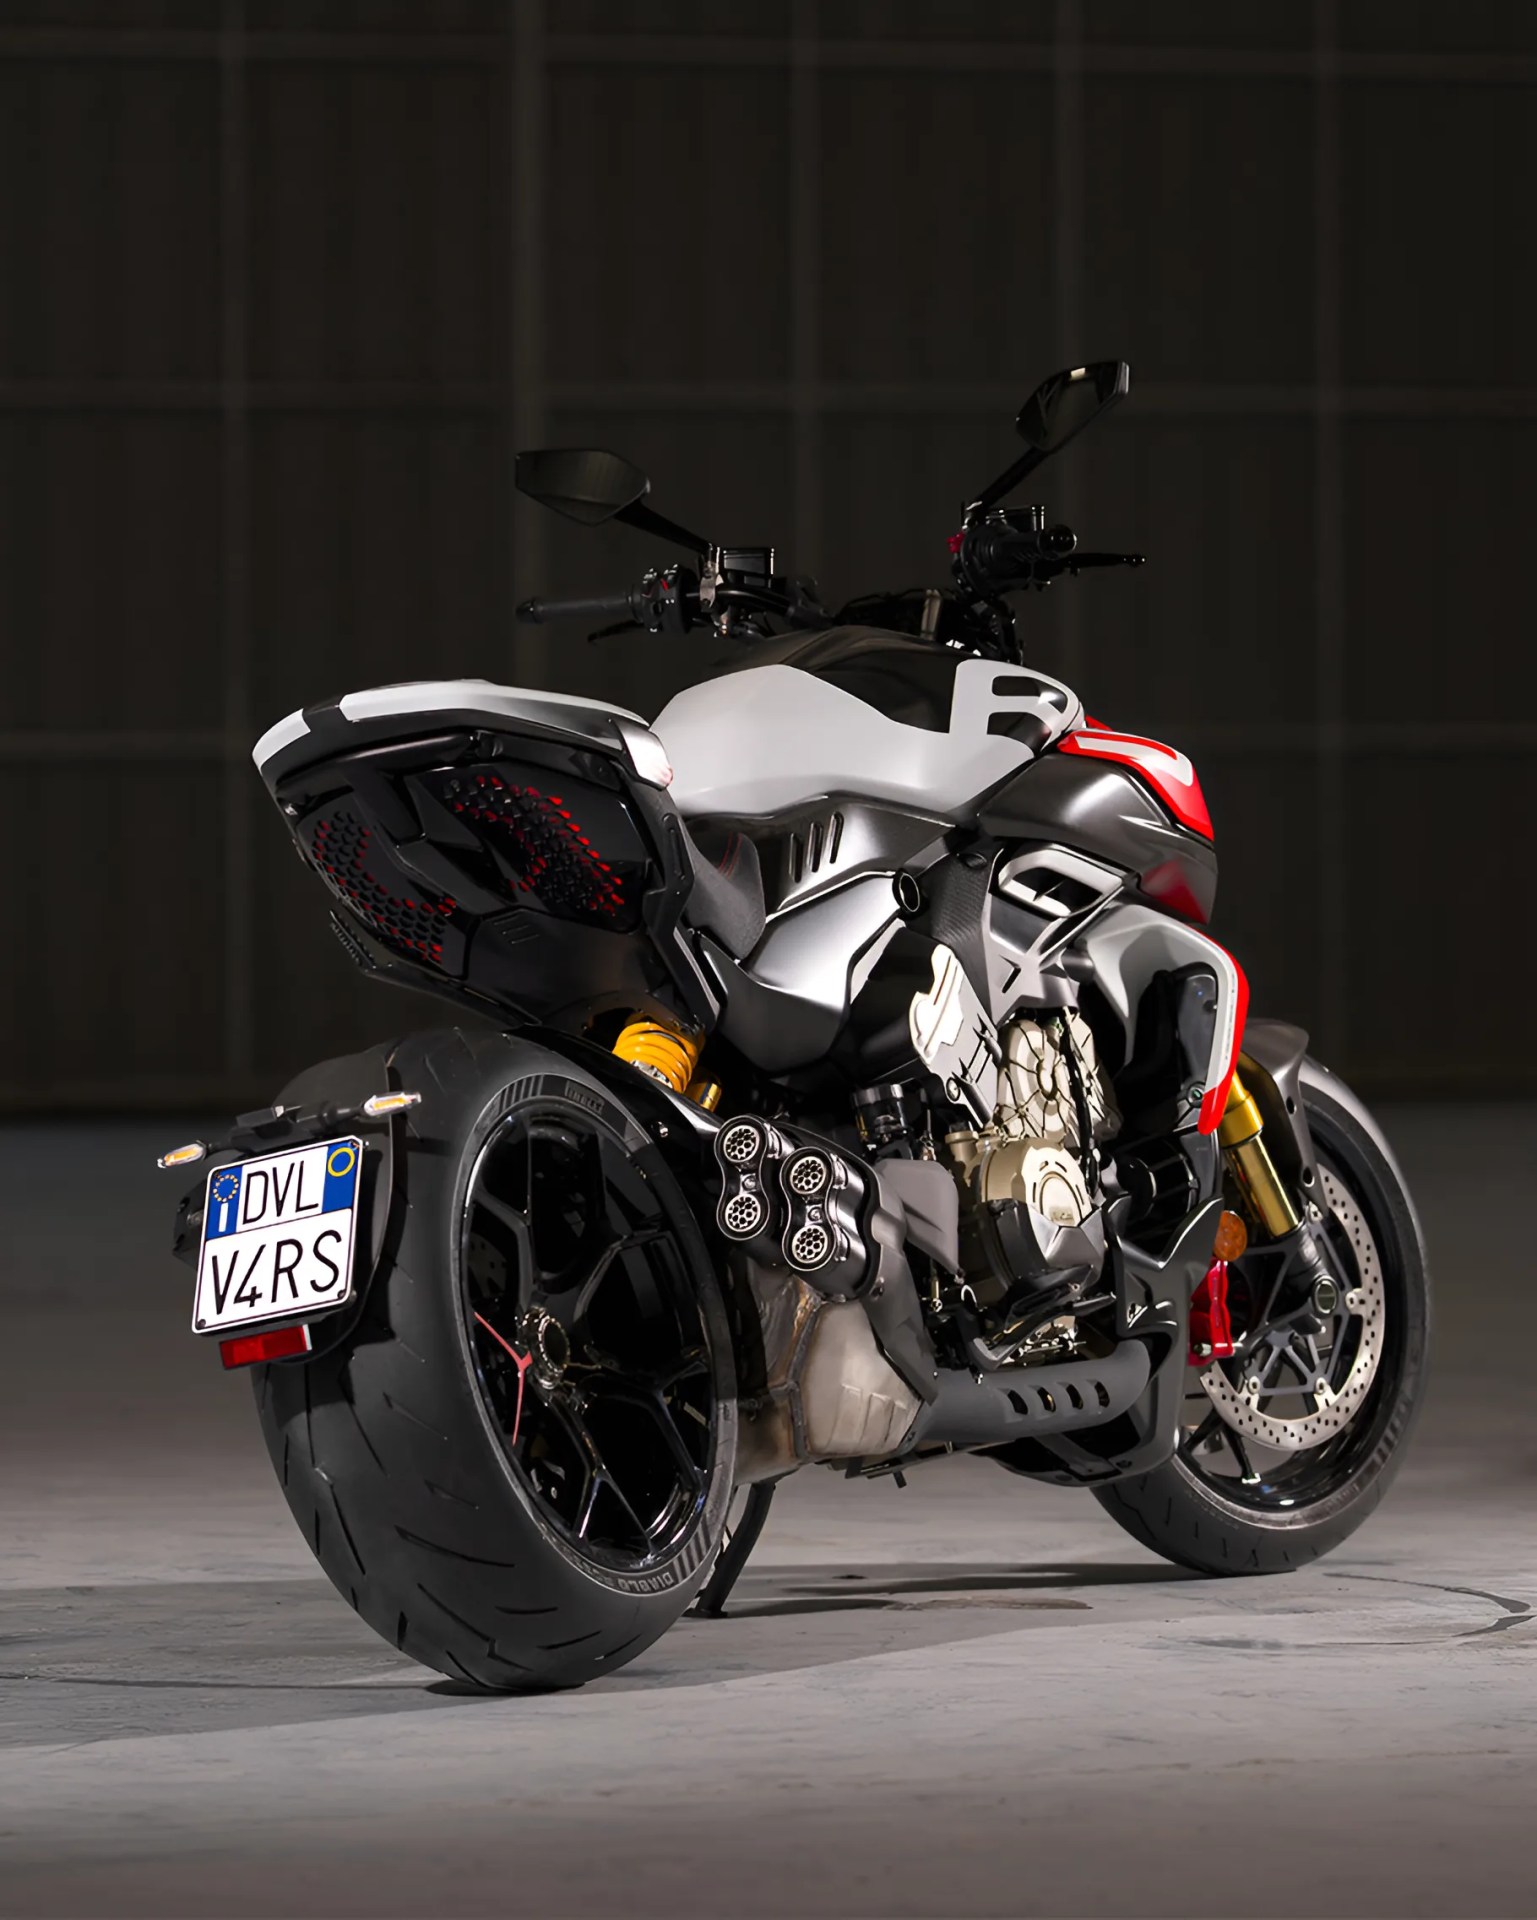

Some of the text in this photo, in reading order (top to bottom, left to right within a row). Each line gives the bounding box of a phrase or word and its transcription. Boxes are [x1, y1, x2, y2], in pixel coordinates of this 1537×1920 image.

[242, 1160, 320, 1226] DVL
[211, 1229, 342, 1315] V4RS
[617, 1571, 675, 1593] DIABLO
